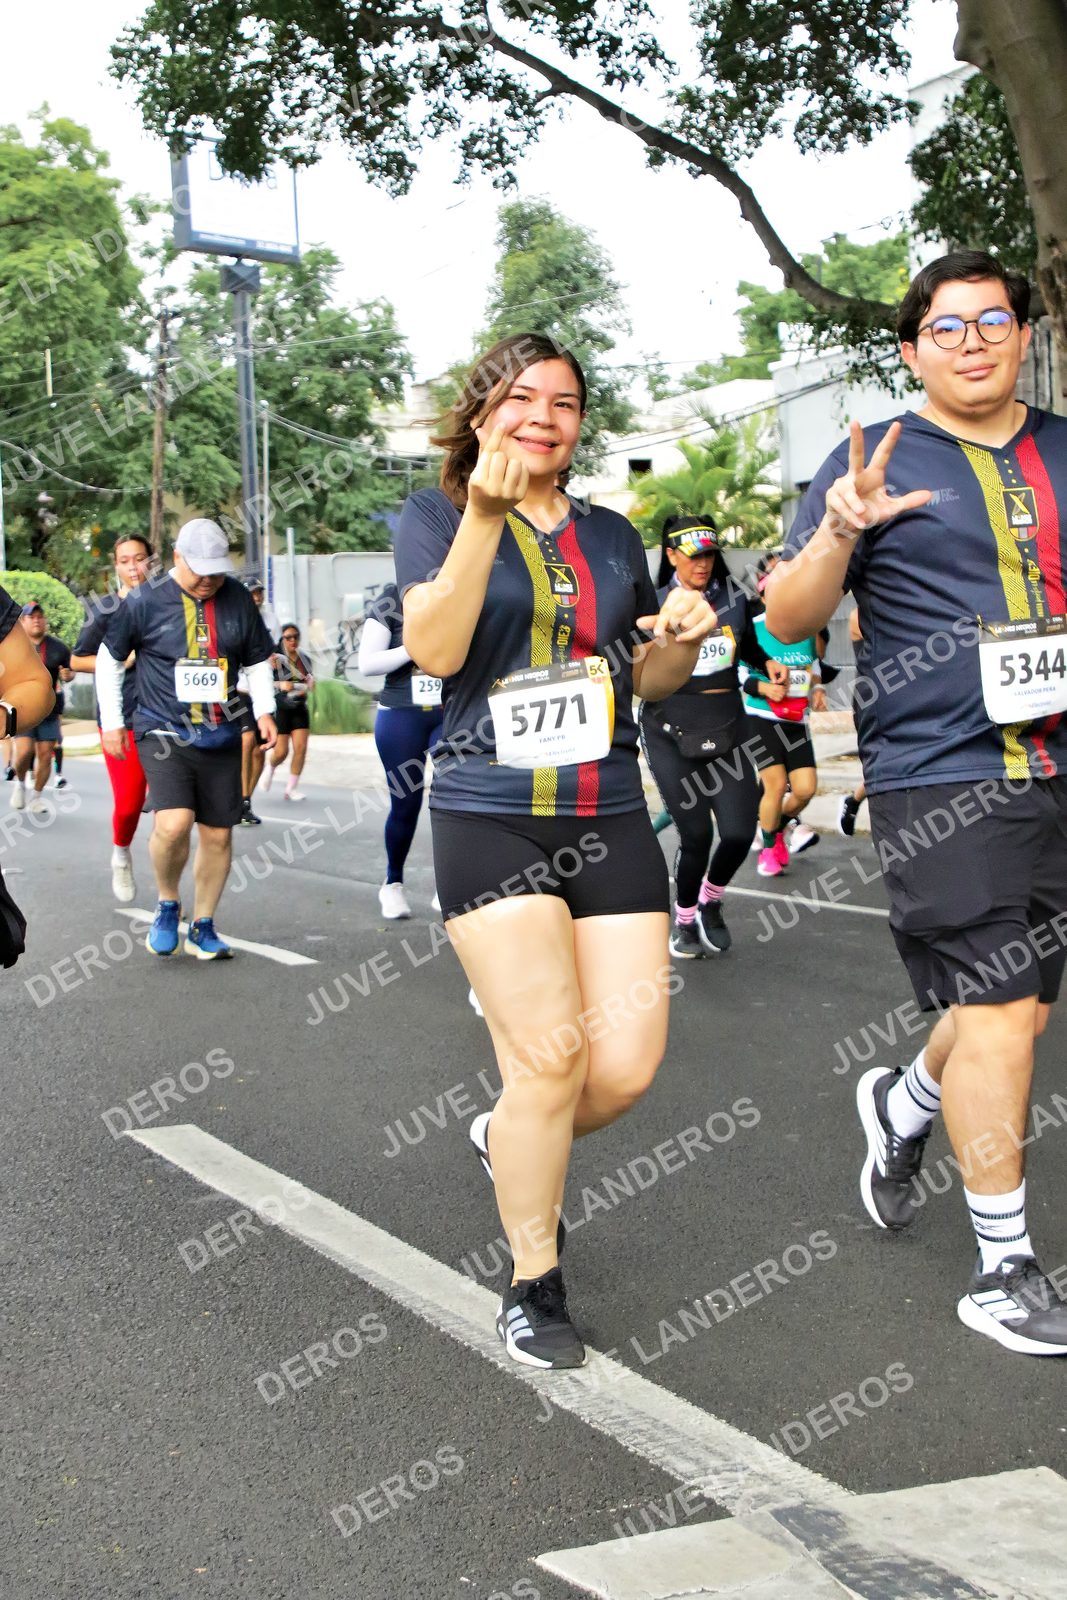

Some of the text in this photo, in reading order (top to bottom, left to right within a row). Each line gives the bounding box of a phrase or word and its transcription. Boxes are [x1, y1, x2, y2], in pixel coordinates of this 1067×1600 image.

[697, 642, 726, 660] 396
[589, 663, 605, 676] 5K
[1000, 648, 1066, 686] 5344
[183, 672, 217, 687] 5669
[418, 679, 442, 693] 259
[510, 692, 587, 738] 5771
